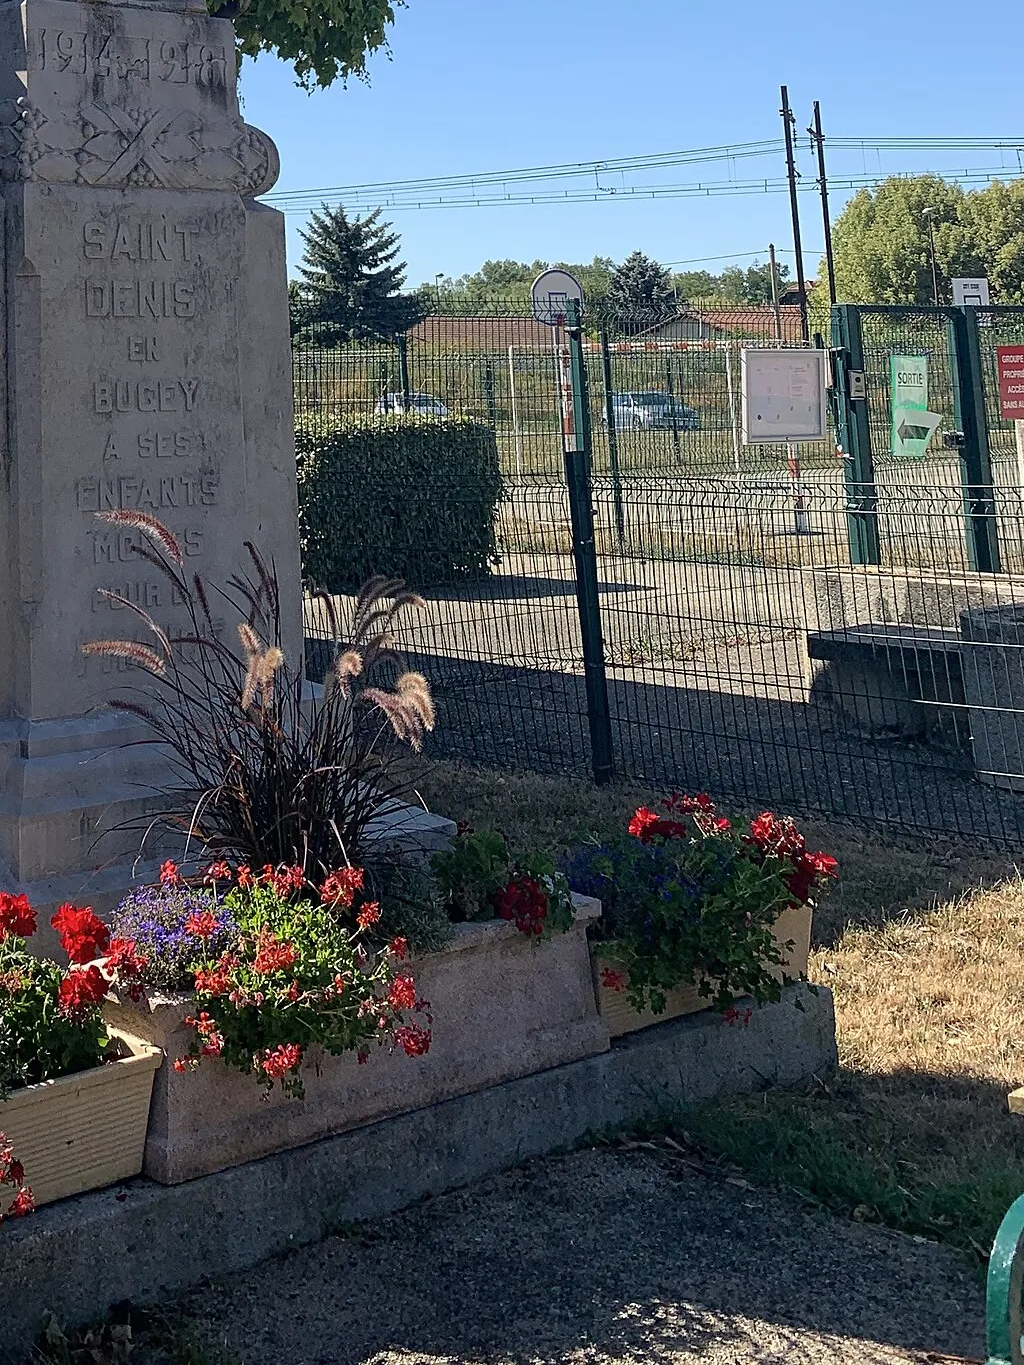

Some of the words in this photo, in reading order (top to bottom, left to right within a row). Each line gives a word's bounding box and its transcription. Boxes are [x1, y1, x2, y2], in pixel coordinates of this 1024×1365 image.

[83, 222, 198, 262] SAINT
[84, 281, 196, 318] DENIS
[128, 337, 160, 362] EN
[1002, 354, 1024, 364] GROUPE
[897, 372, 924, 385] SORTIE
[94, 379, 199, 413] BUGEY
[1003, 400, 1018, 410] SANS
[102, 434, 122, 461] A
[138, 434, 192, 458] SES
[76, 476, 221, 513] ENFANTS
